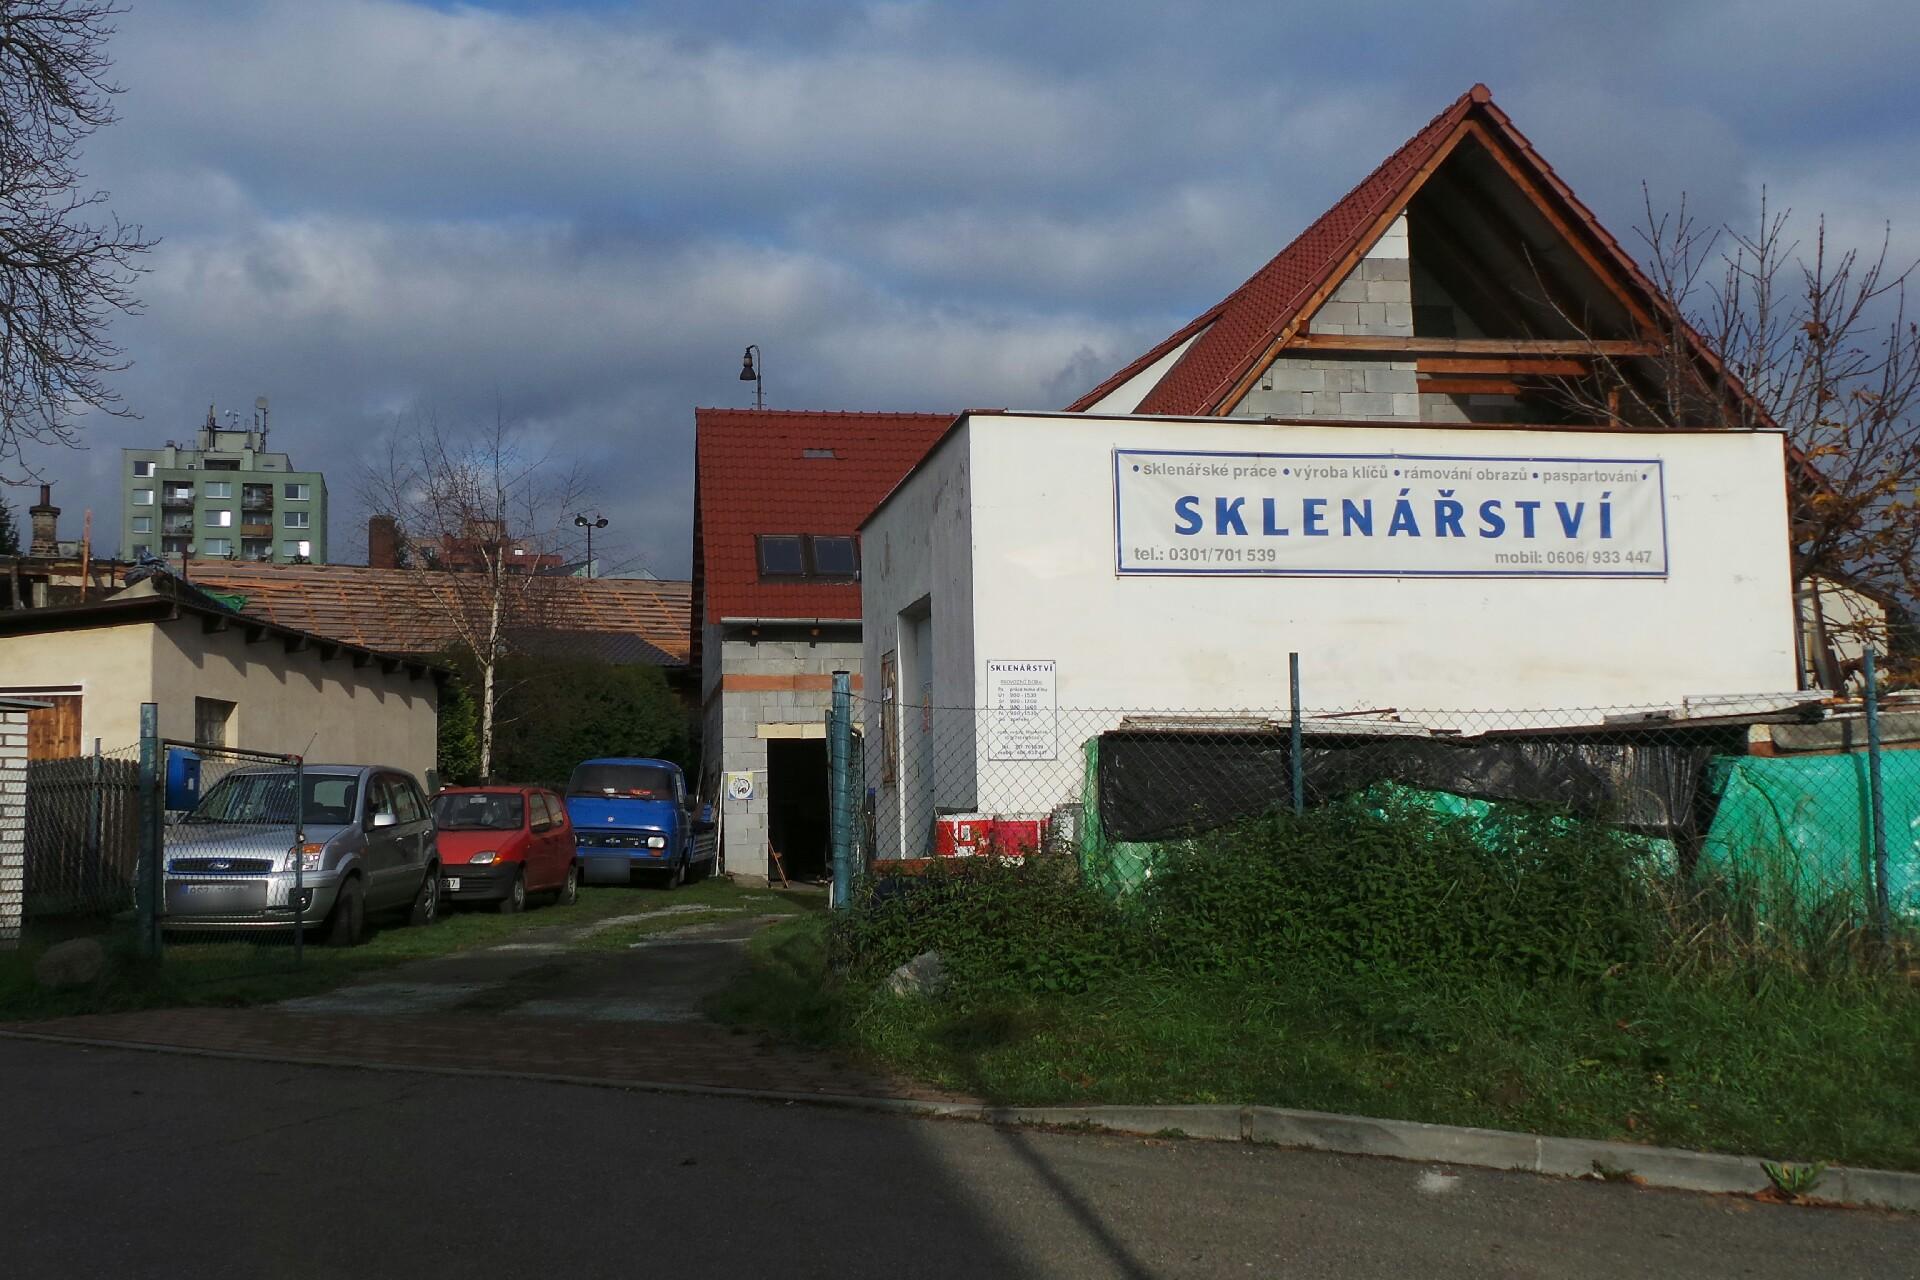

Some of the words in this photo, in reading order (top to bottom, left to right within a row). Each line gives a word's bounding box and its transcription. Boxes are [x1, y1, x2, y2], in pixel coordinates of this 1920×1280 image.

[1143, 463, 1229, 477] sklenářské
[1233, 463, 1277, 479] práce
[1293, 465, 1349, 480] výroba
[1352, 464, 1388, 478] klíčů
[1403, 465, 1472, 480] rámování
[1476, 467, 1528, 481] obrazů
[1543, 469, 1638, 484] paspartování
[1174, 488, 1613, 539] SKLENÁŘSTVÍ
[1134, 547, 1164, 561] tel.:
[1247, 548, 1276, 561] 539
[1495, 550, 1542, 564] mobil:
[1625, 550, 1653, 563] 447
[990, 663, 1053, 672] SKLENÁŘSTVÍ
